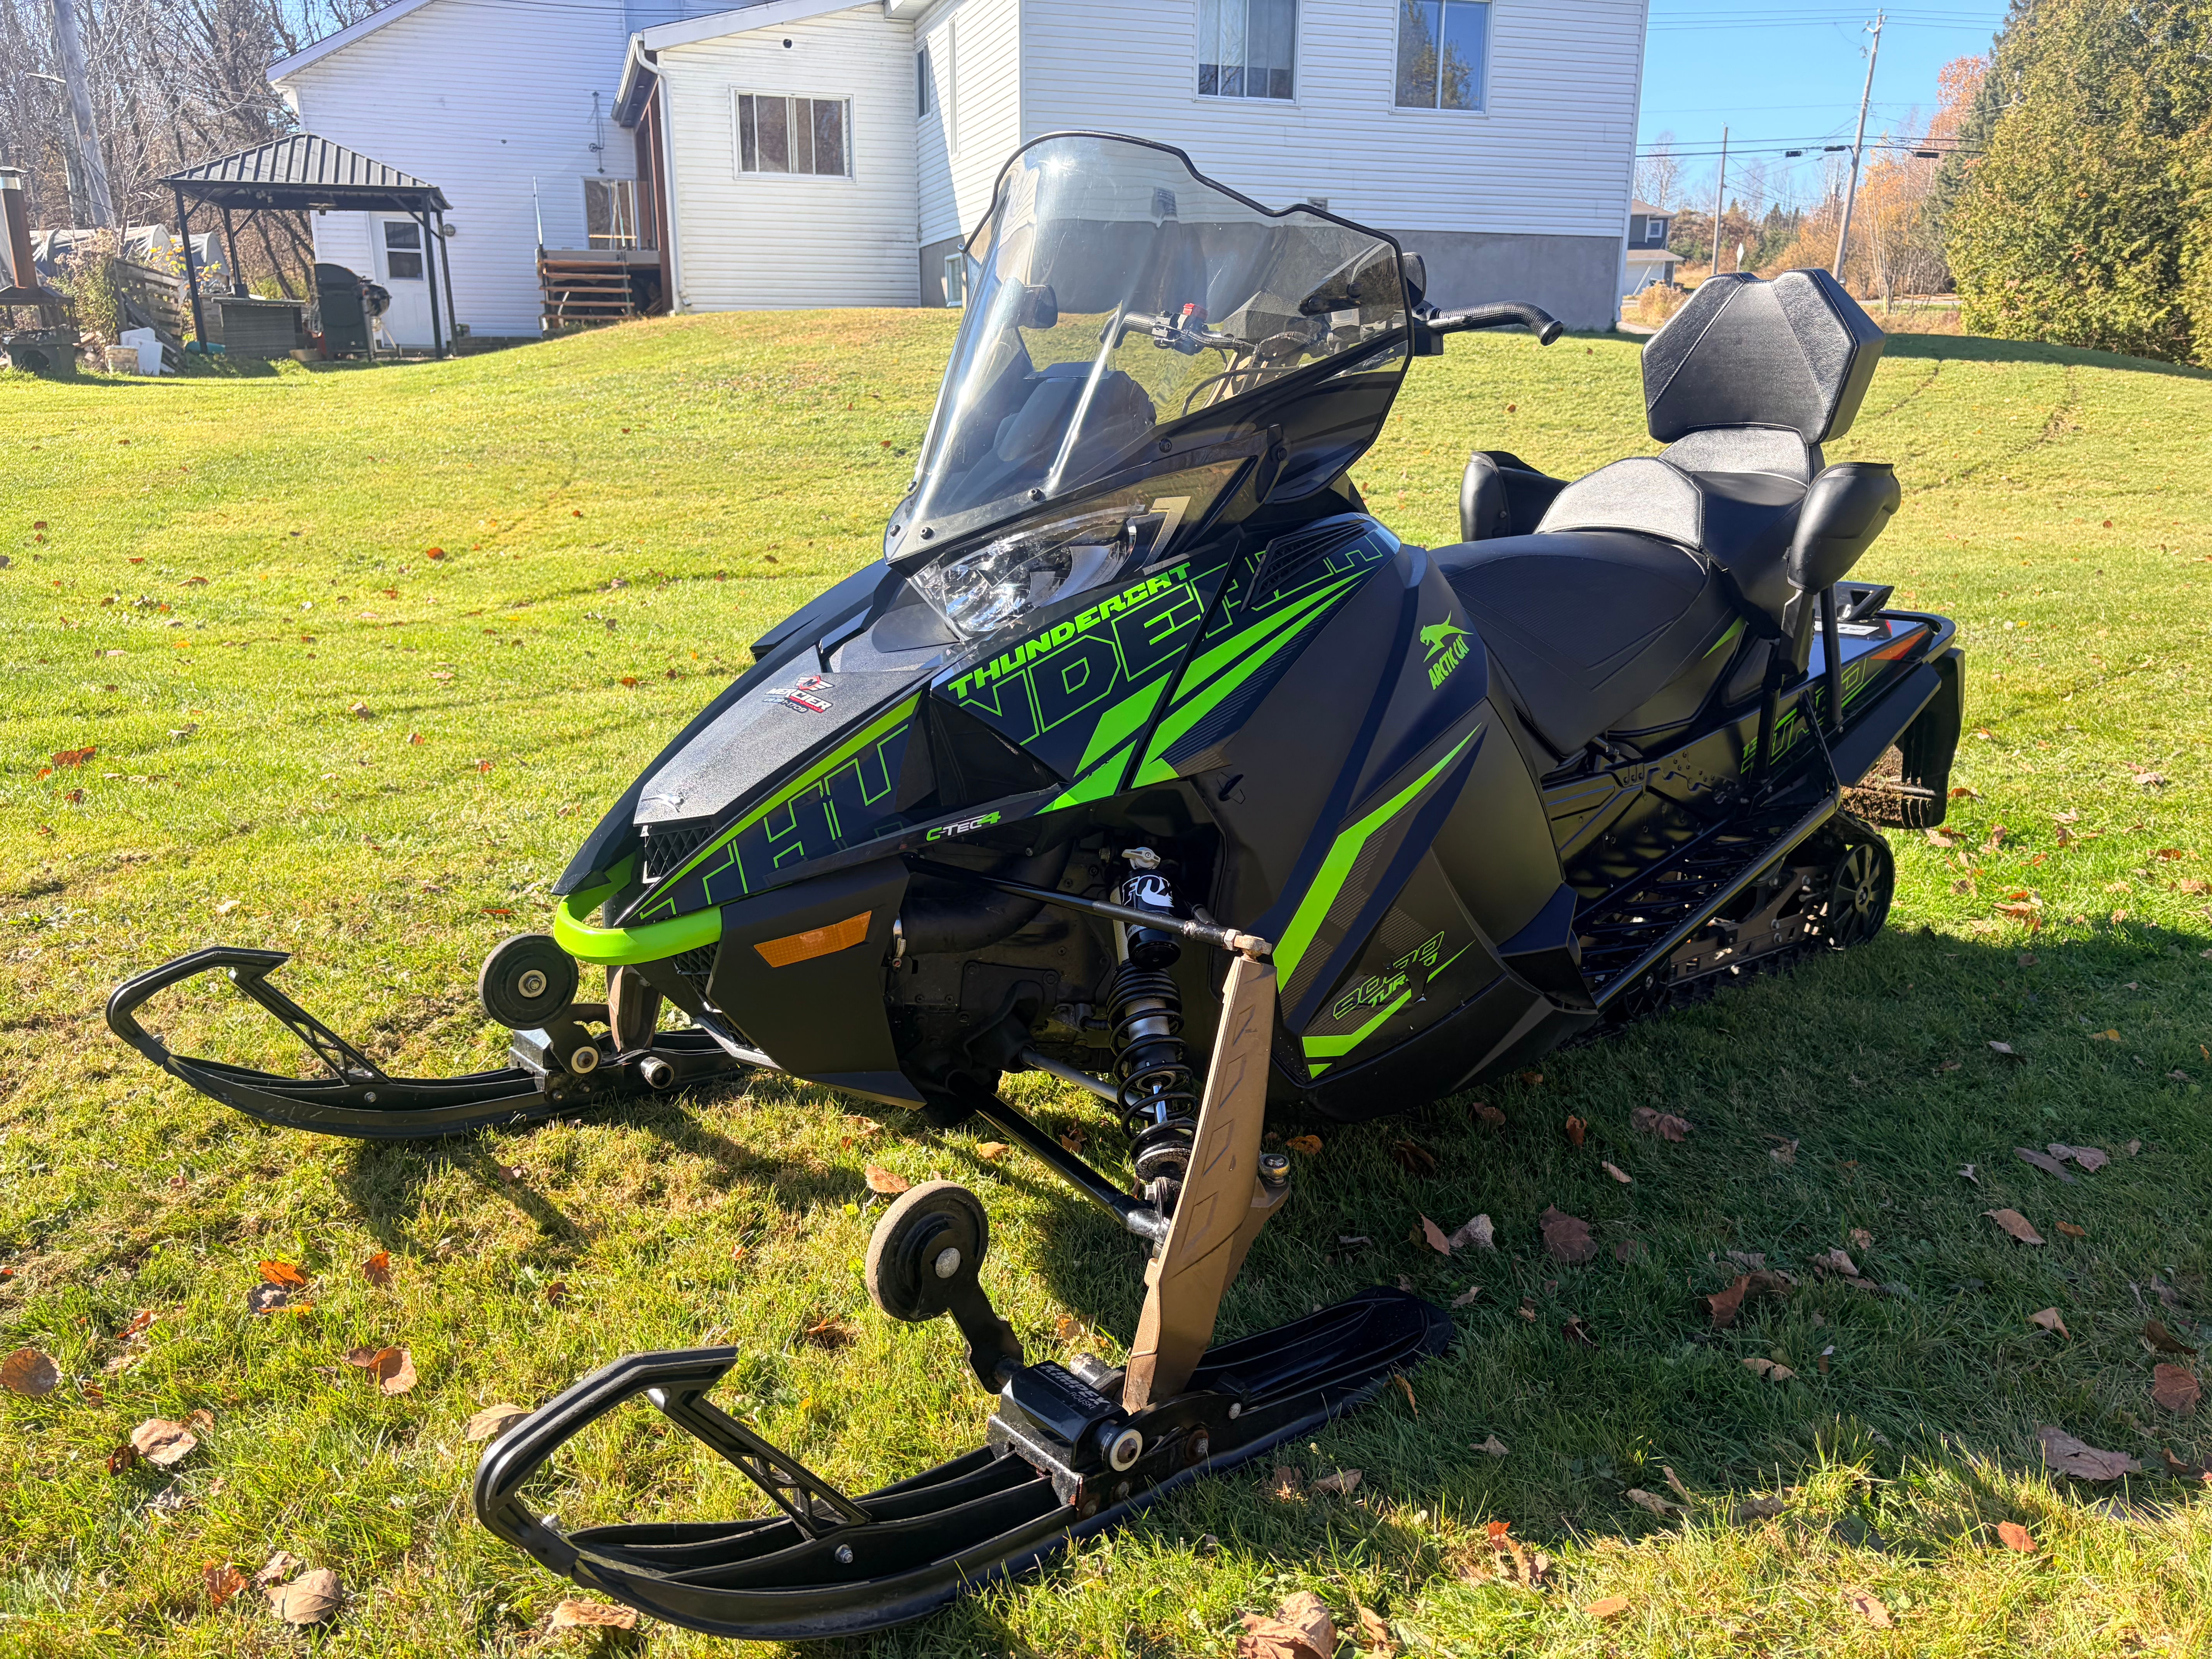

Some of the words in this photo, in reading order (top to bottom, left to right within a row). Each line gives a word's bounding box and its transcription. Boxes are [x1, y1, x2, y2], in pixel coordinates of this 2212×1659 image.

[948, 562, 1190, 699] THUNDERCAT
[1428, 646, 1459, 690] ARCTIC
[1453, 634, 1470, 659] CAT
[766, 688, 832, 710] MERCIER
[926, 811, 1001, 841] C-TEC4
[1122, 874, 1175, 907] FOX
[1039, 1365, 1111, 1405] KIMPEX
[1069, 1391, 1097, 1410] ROUSKI
